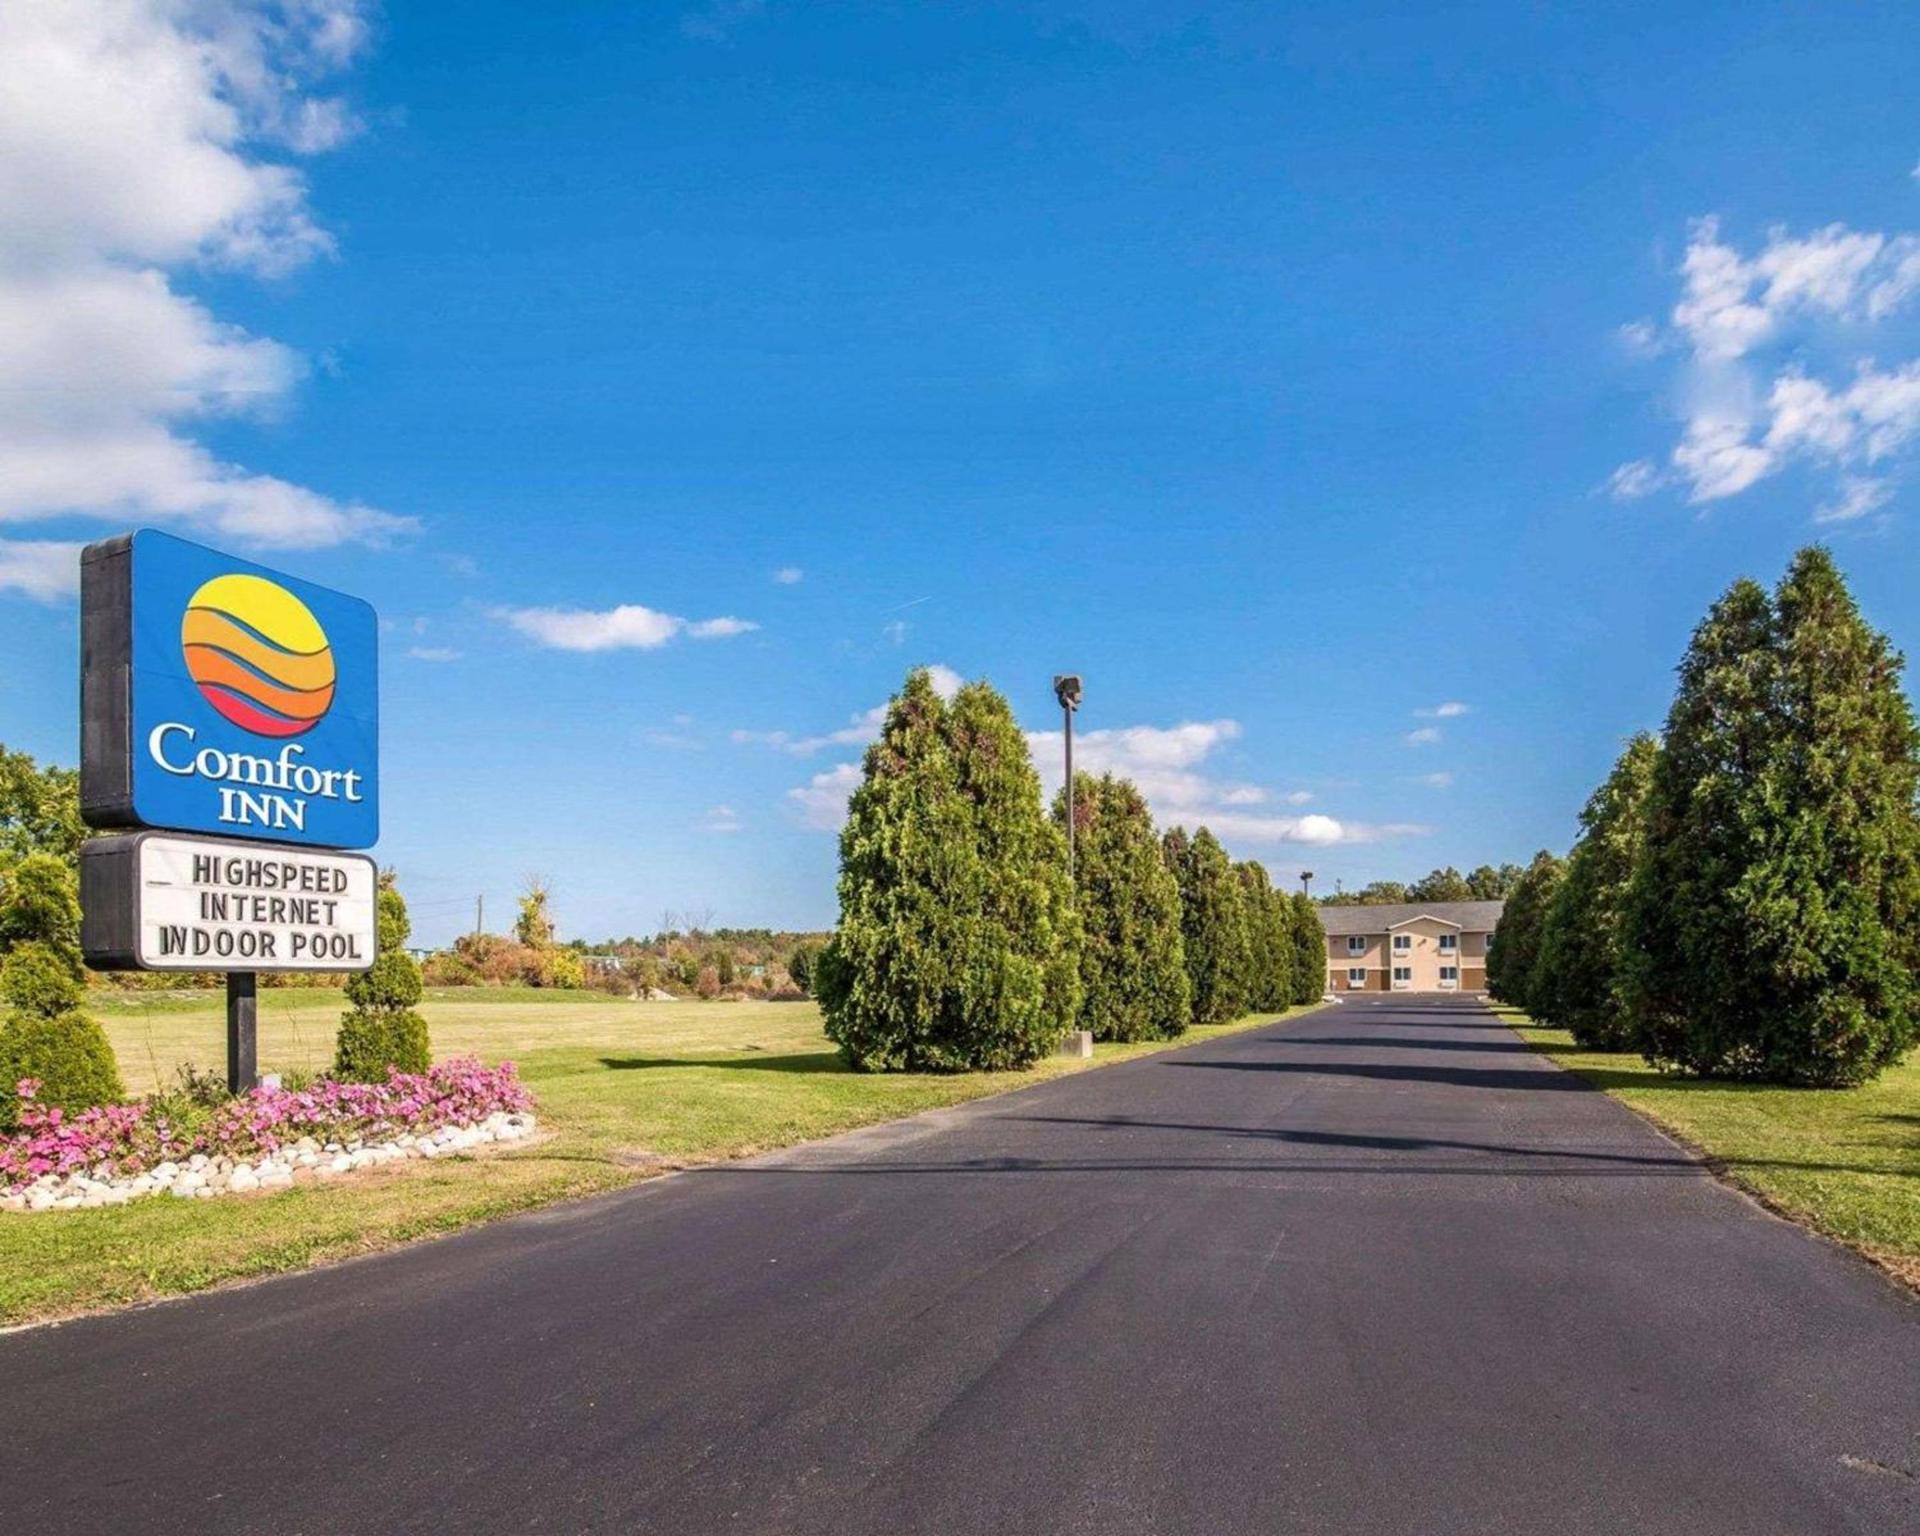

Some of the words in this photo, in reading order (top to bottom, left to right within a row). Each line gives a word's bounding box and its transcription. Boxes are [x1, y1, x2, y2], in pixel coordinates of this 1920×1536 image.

[149, 722, 363, 802] Comfort
[218, 787, 306, 831] INN
[193, 854, 348, 893] HIGHSPEED
[200, 891, 338, 926] INTERNET
[159, 925, 276, 958] INDOOR
[291, 932, 362, 960] POOL
